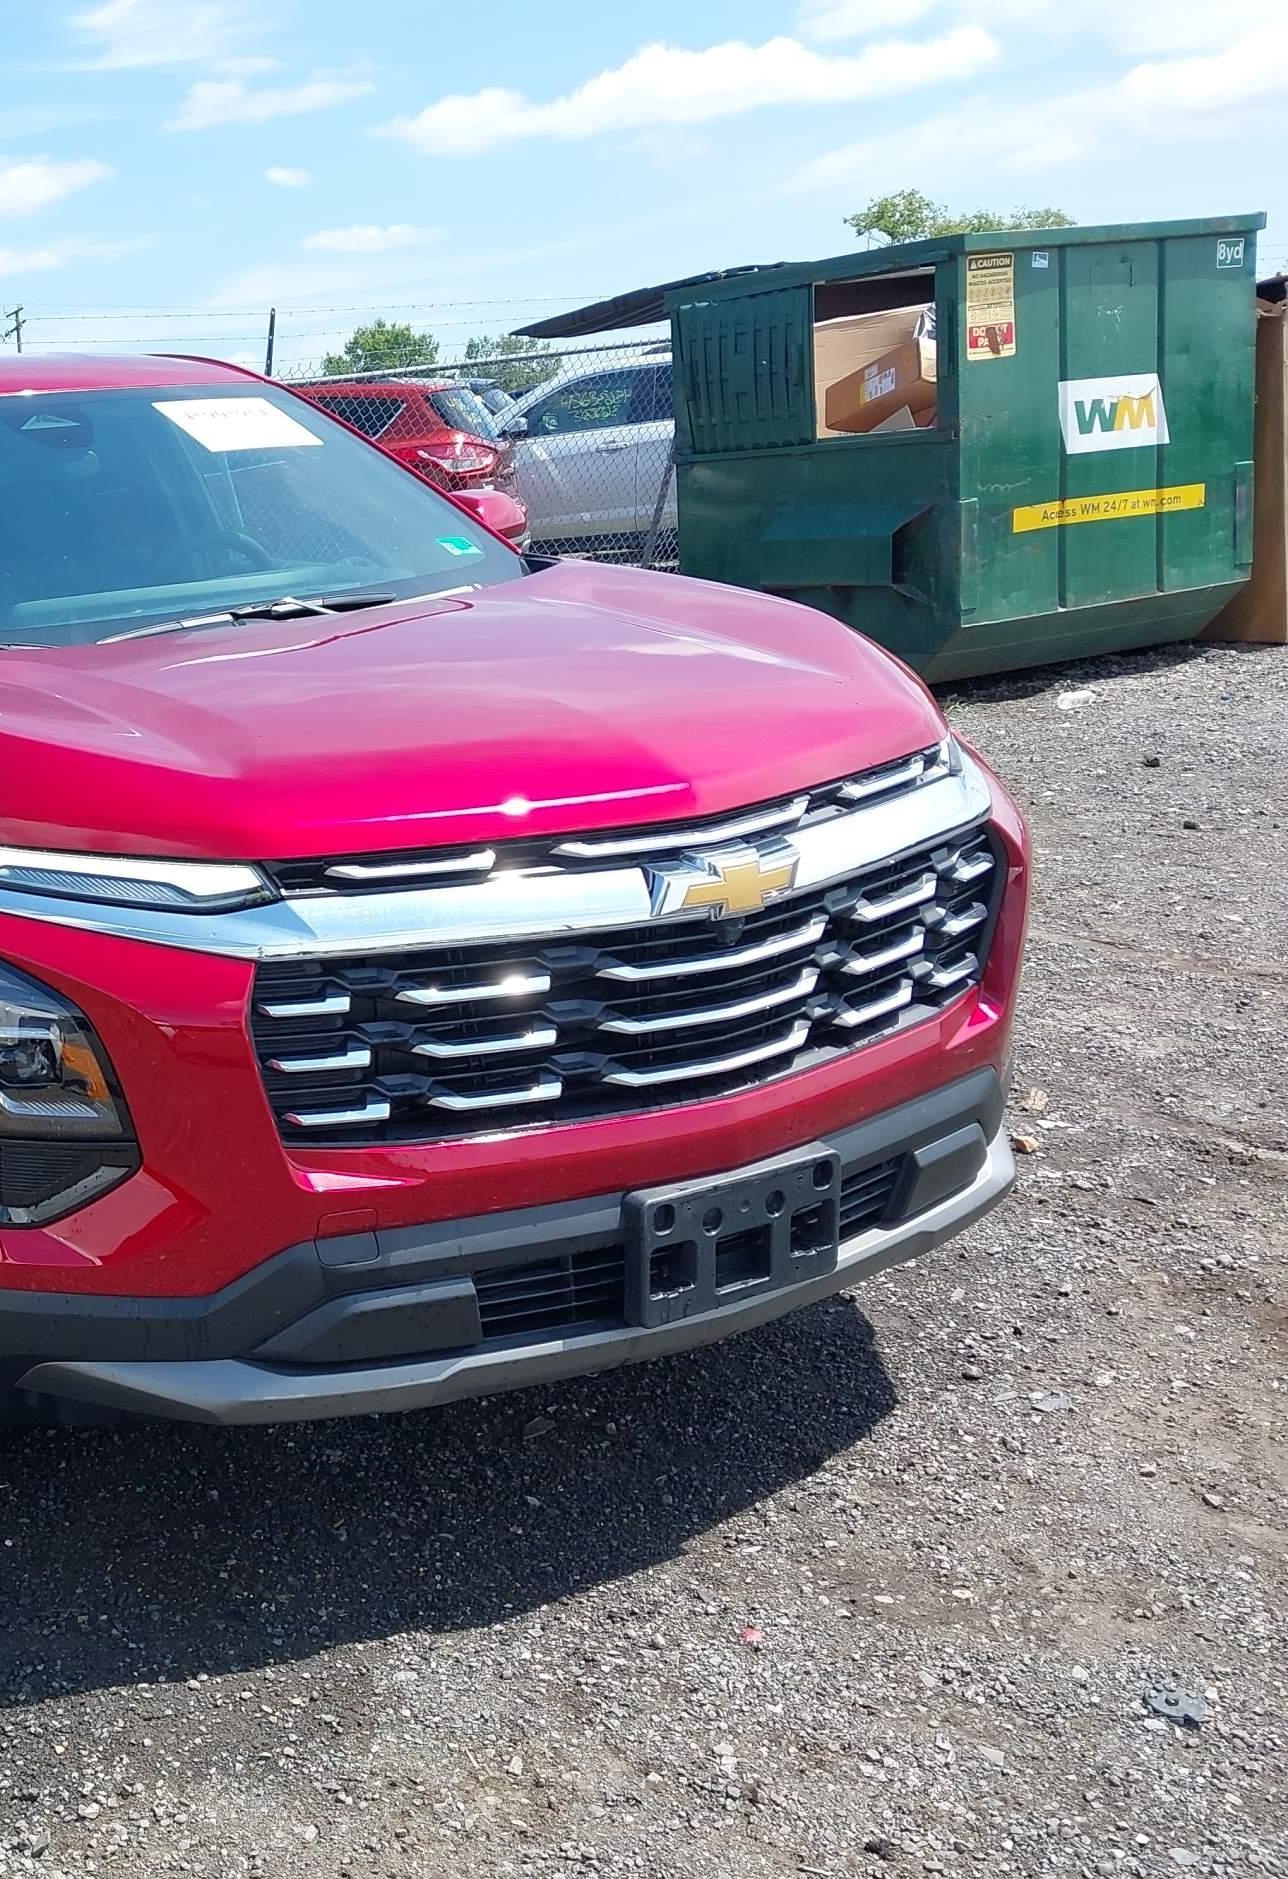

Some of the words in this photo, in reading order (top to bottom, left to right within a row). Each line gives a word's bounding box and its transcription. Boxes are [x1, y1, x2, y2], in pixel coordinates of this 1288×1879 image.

[1219, 241, 1242, 264] 8yd
[977, 257, 1011, 268] CAUTION
[972, 327, 986, 337] DO
[1074, 394, 1156, 435] WM
[1080, 502, 1100, 516] WM
[1103, 499, 1128, 513] 24/7
[1131, 499, 1140, 510] at
